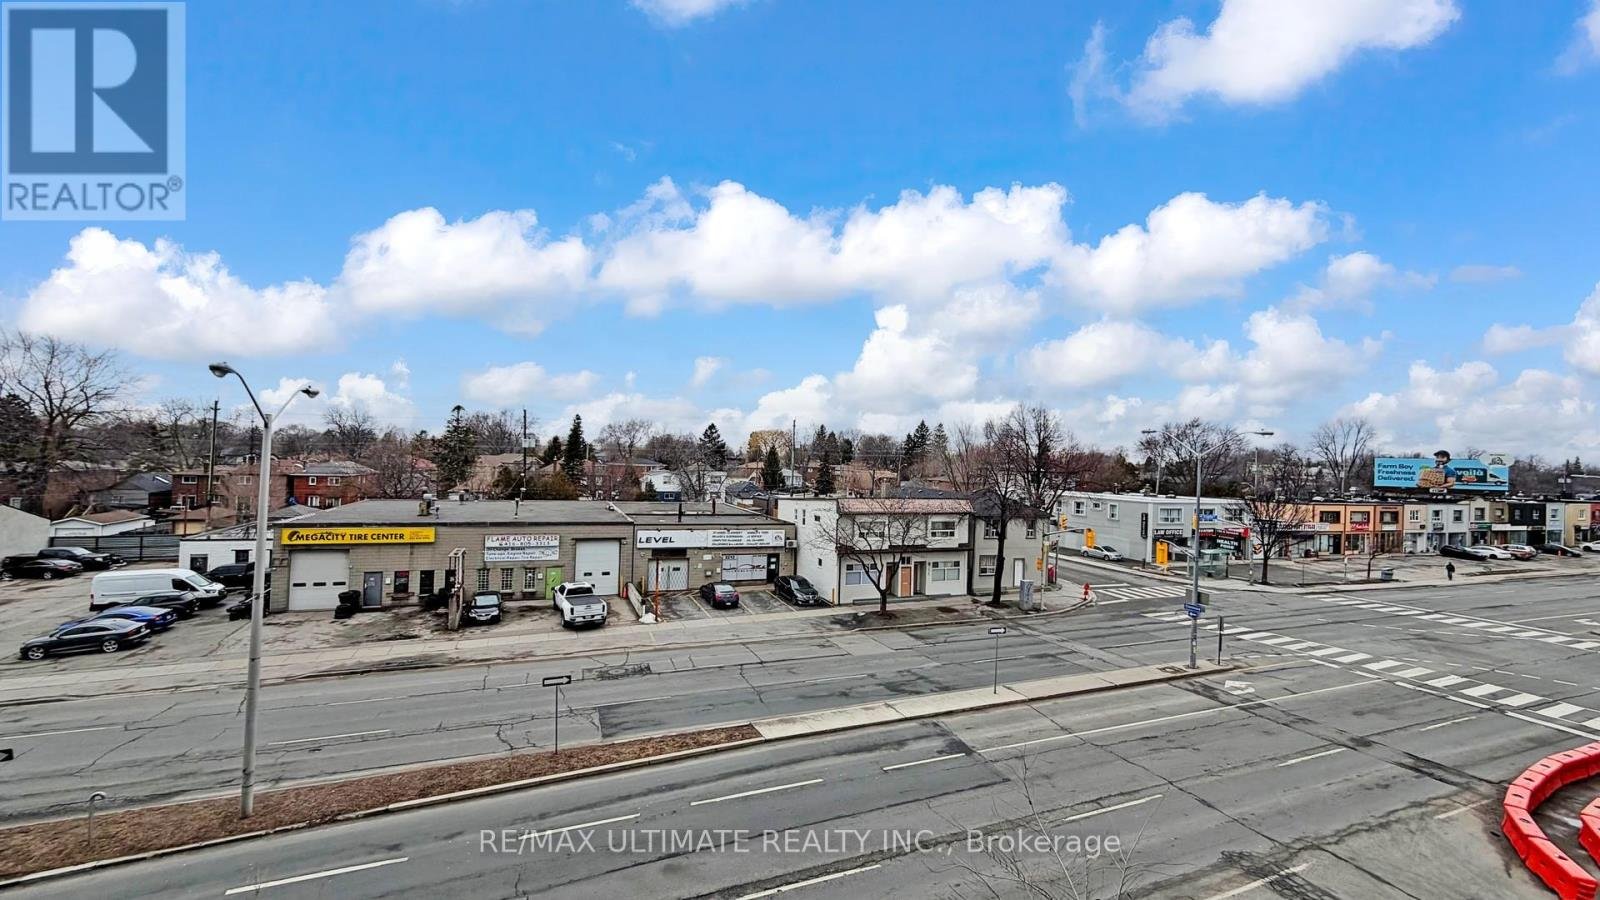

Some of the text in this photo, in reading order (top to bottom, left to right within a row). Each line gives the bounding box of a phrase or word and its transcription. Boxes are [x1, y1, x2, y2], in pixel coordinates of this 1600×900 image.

[1398, 463, 1414, 471] Boy
[295, 533, 347, 541] MEGACITY
[638, 536, 675, 544] LEVEL
